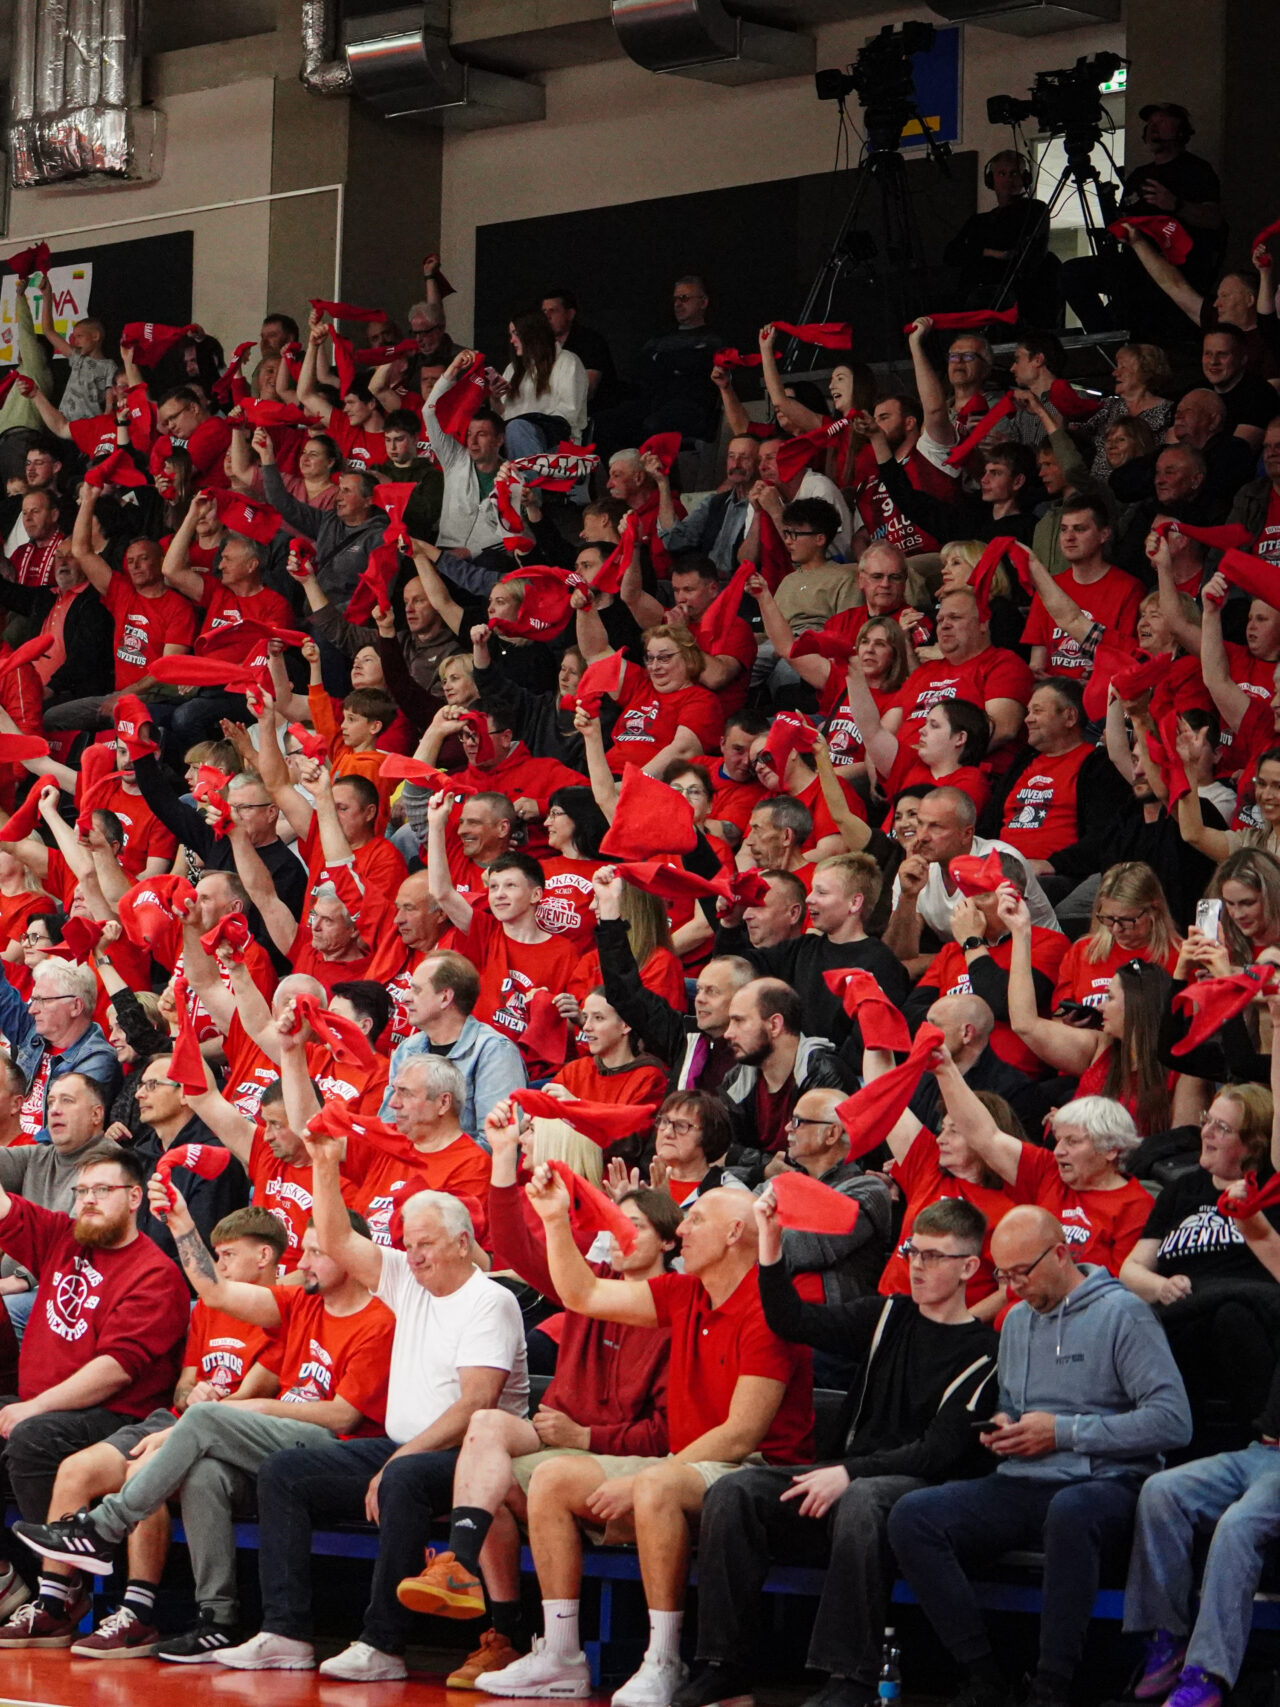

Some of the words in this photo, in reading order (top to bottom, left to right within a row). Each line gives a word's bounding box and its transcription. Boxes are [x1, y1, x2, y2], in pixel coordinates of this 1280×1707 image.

[881, 498, 894, 517] 9
[1016, 788, 1055, 800] JUVENTUS
[493, 1010, 529, 1033] JUVEN
[1156, 1216, 1246, 1258] JUVENTUS
[45, 1299, 89, 1342] JUVENTUS
[201, 1351, 244, 1377] UTENOS
